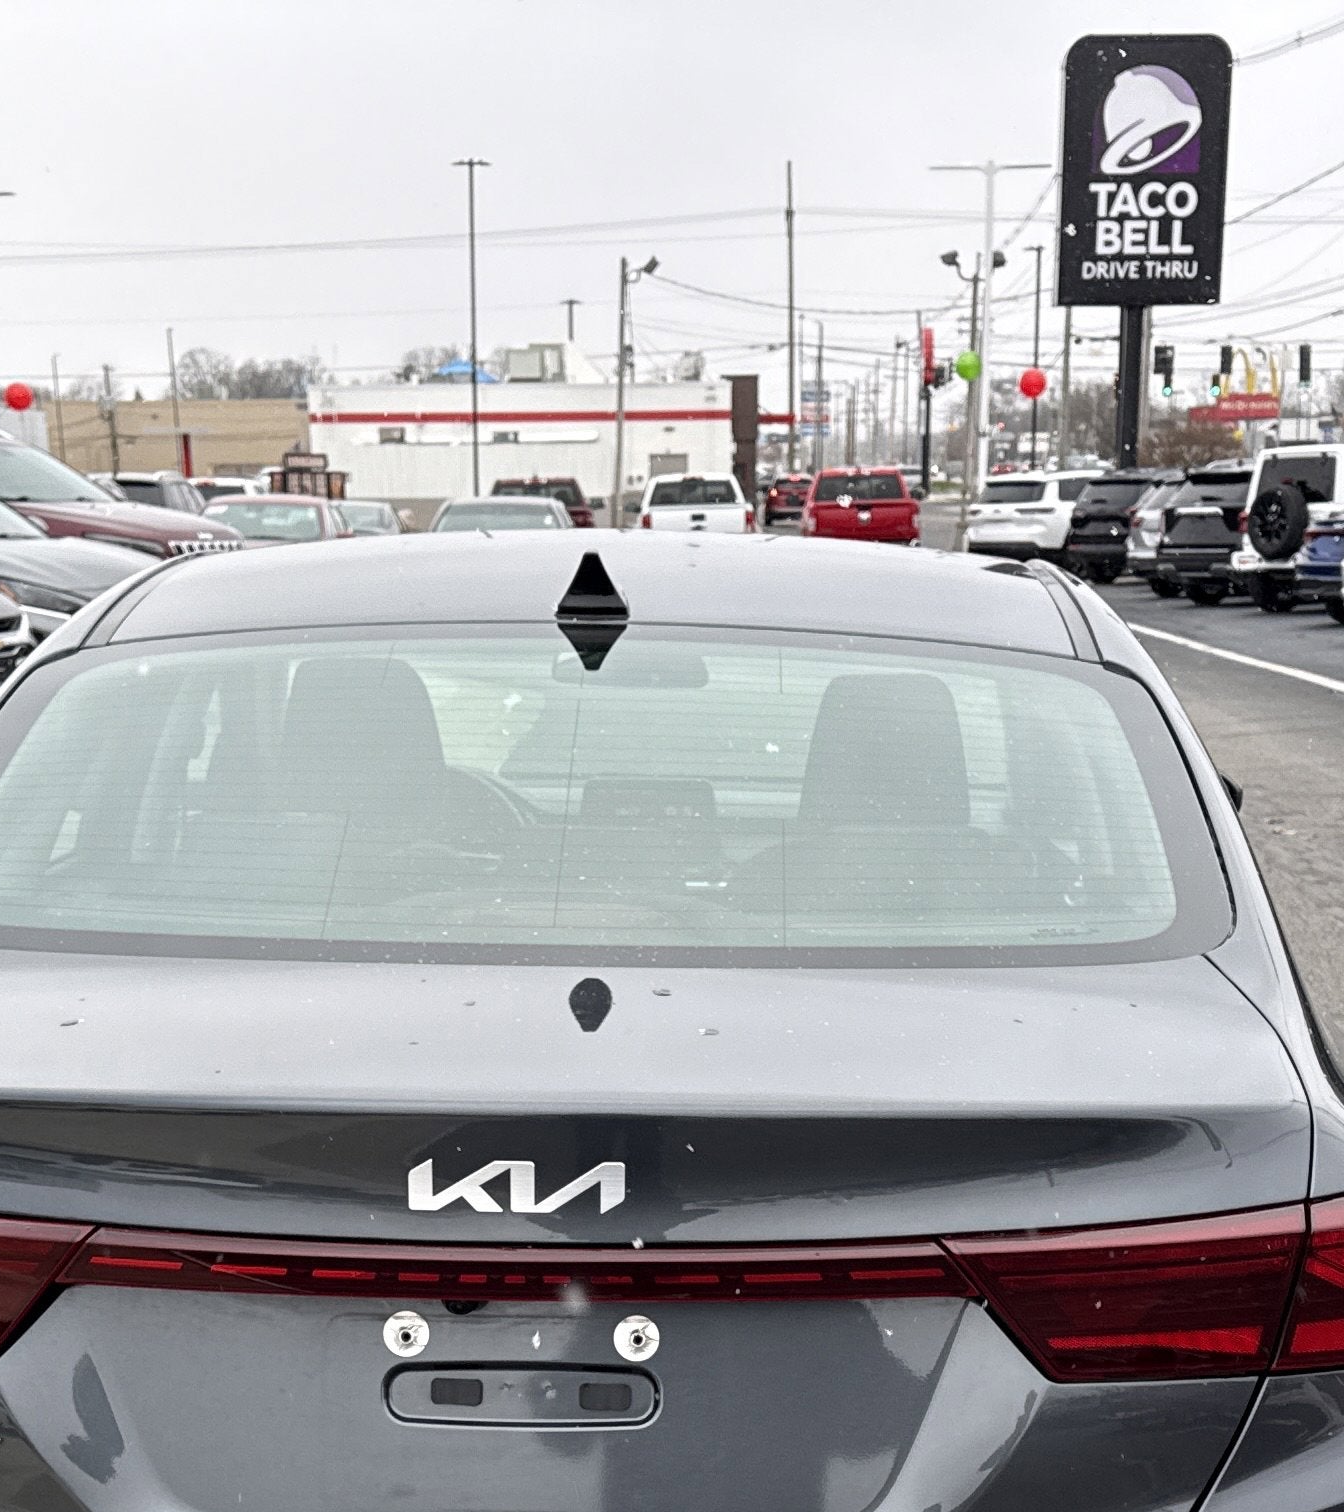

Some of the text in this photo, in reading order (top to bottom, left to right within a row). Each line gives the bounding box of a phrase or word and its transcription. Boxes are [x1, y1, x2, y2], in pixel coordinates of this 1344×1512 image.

[1088, 181, 1199, 218] TACO
[1095, 219, 1195, 255] BELL
[1081, 260, 1199, 280] DRIVE THRU
[407, 1157, 626, 1215] KIA
